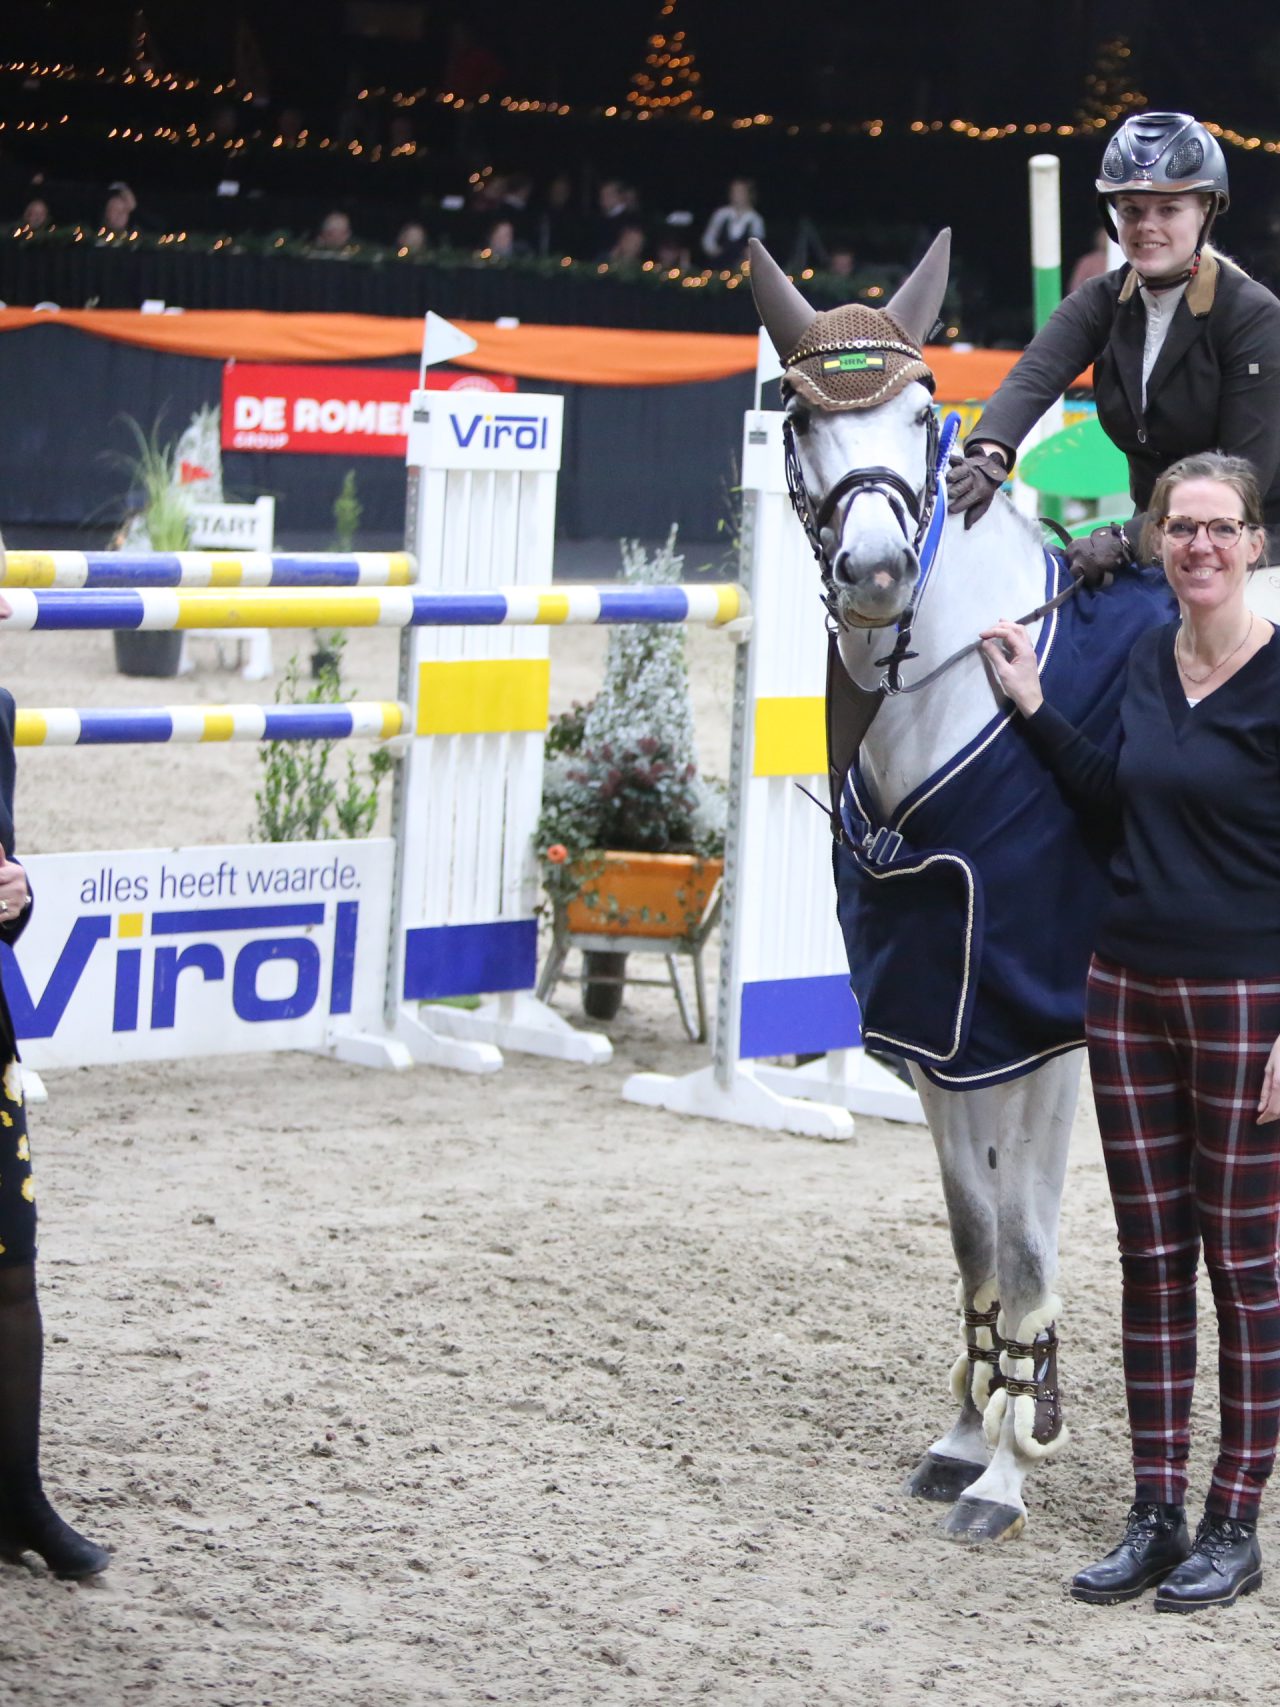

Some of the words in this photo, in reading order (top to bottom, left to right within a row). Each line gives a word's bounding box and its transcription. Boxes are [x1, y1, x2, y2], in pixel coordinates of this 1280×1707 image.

[234, 396, 287, 431] DE
[294, 398, 410, 436] ROME
[449, 414, 548, 449] Virol
[80, 868, 149, 904] alles
[160, 861, 238, 900] heeft
[247, 857, 362, 894] waarde.
[0, 901, 360, 1040] Virol
